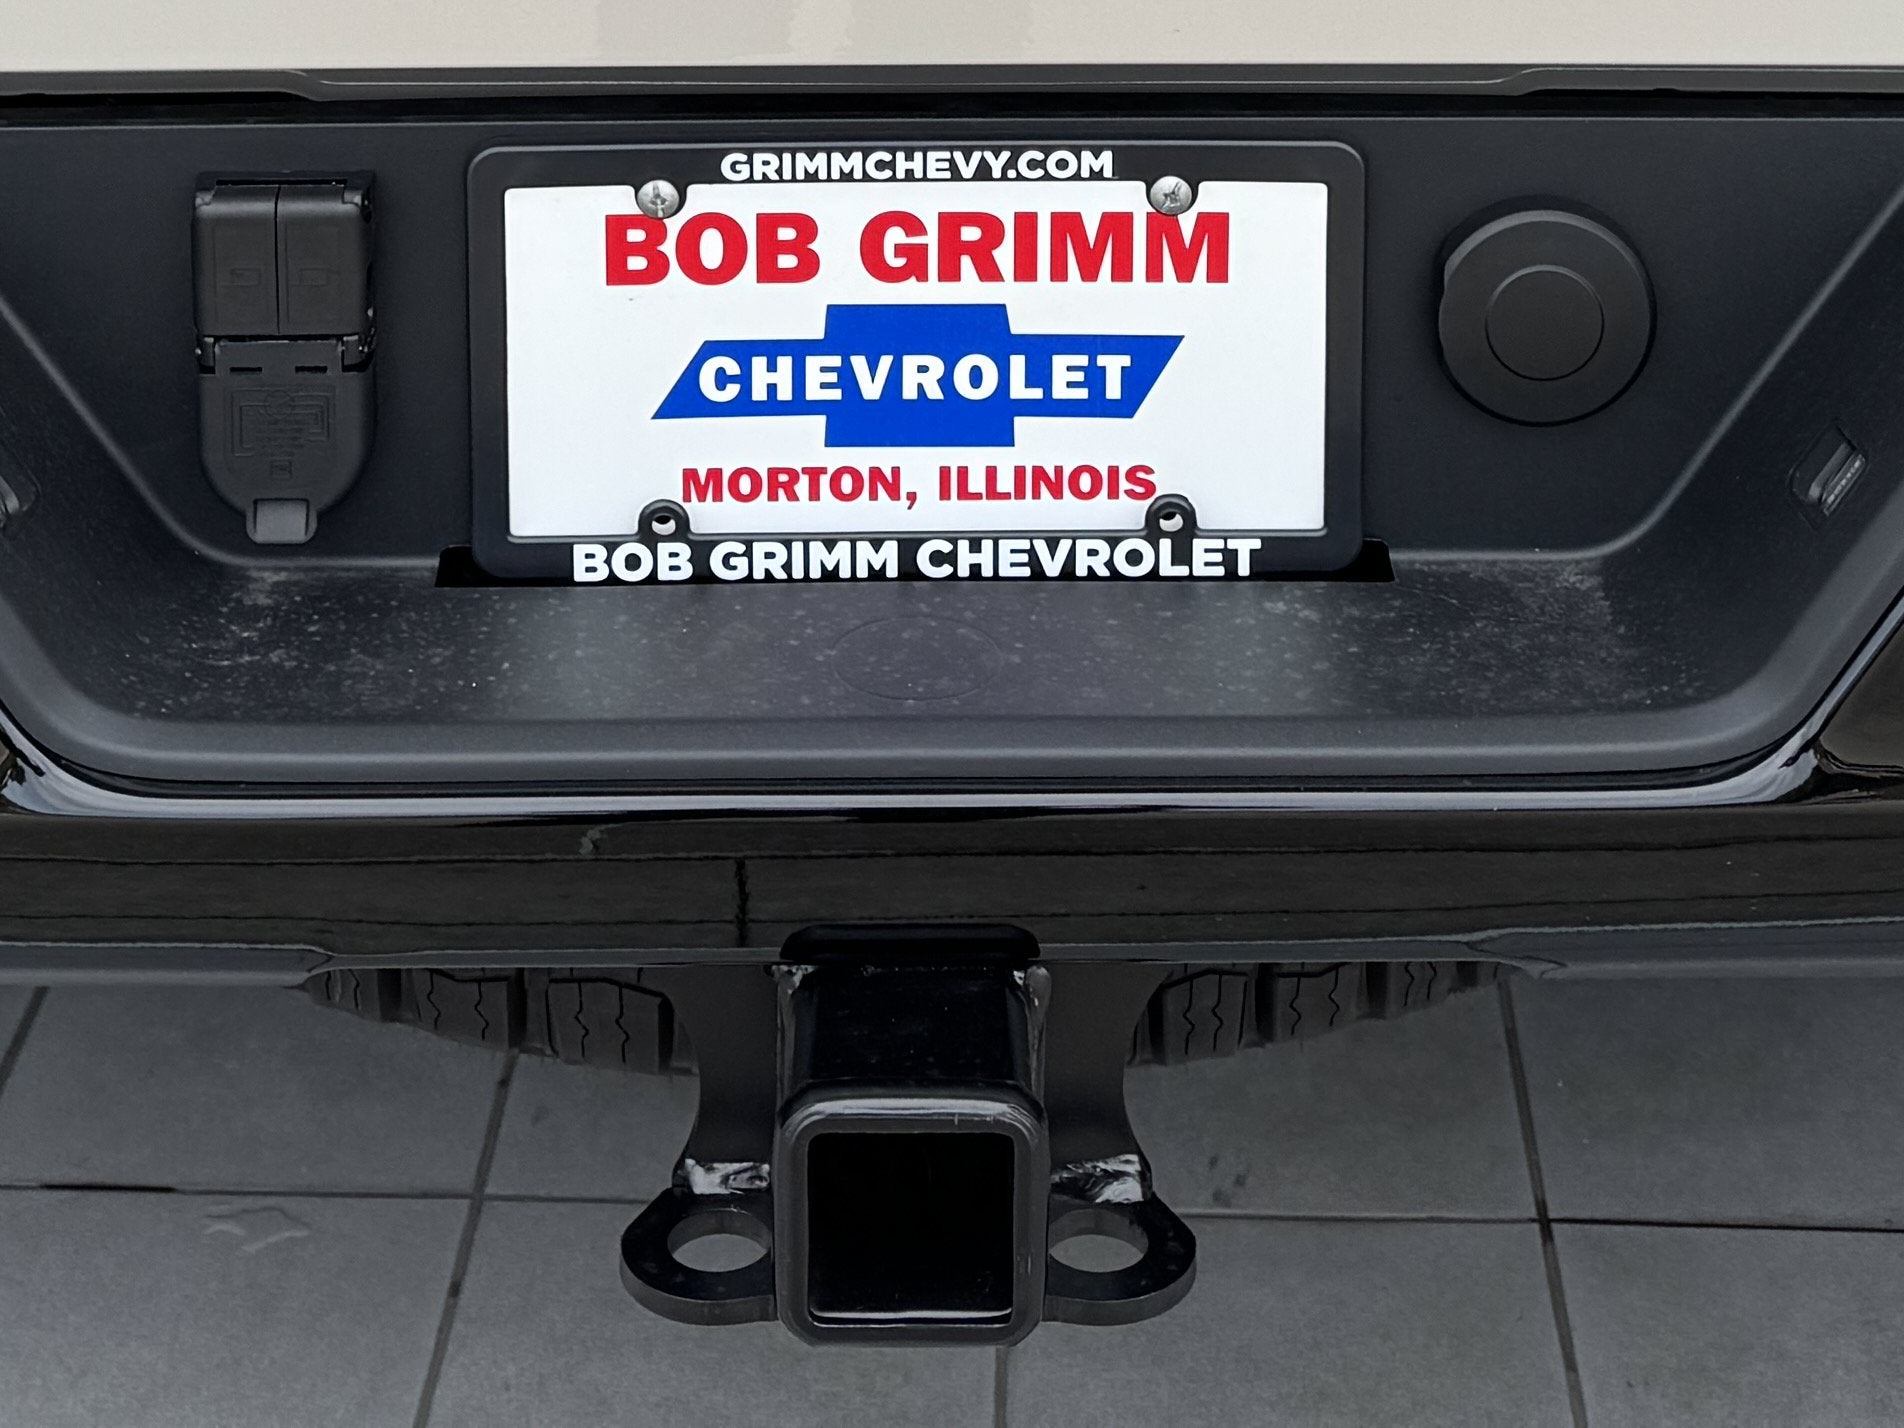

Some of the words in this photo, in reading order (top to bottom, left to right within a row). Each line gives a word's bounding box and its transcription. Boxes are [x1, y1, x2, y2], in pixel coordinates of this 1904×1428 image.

[720, 150, 1114, 181] GRIMMCHEVY.COM
[605, 212, 821, 286] BOB
[859, 210, 1230, 284] GRIMM
[697, 353, 1131, 402] CHEVROLET
[681, 465, 919, 510] MORTON,
[938, 464, 1157, 502] ILLINOIS
[572, 541, 693, 582] BOB
[709, 540, 899, 581] GRIMM
[916, 537, 1262, 579] CHEVROLET
